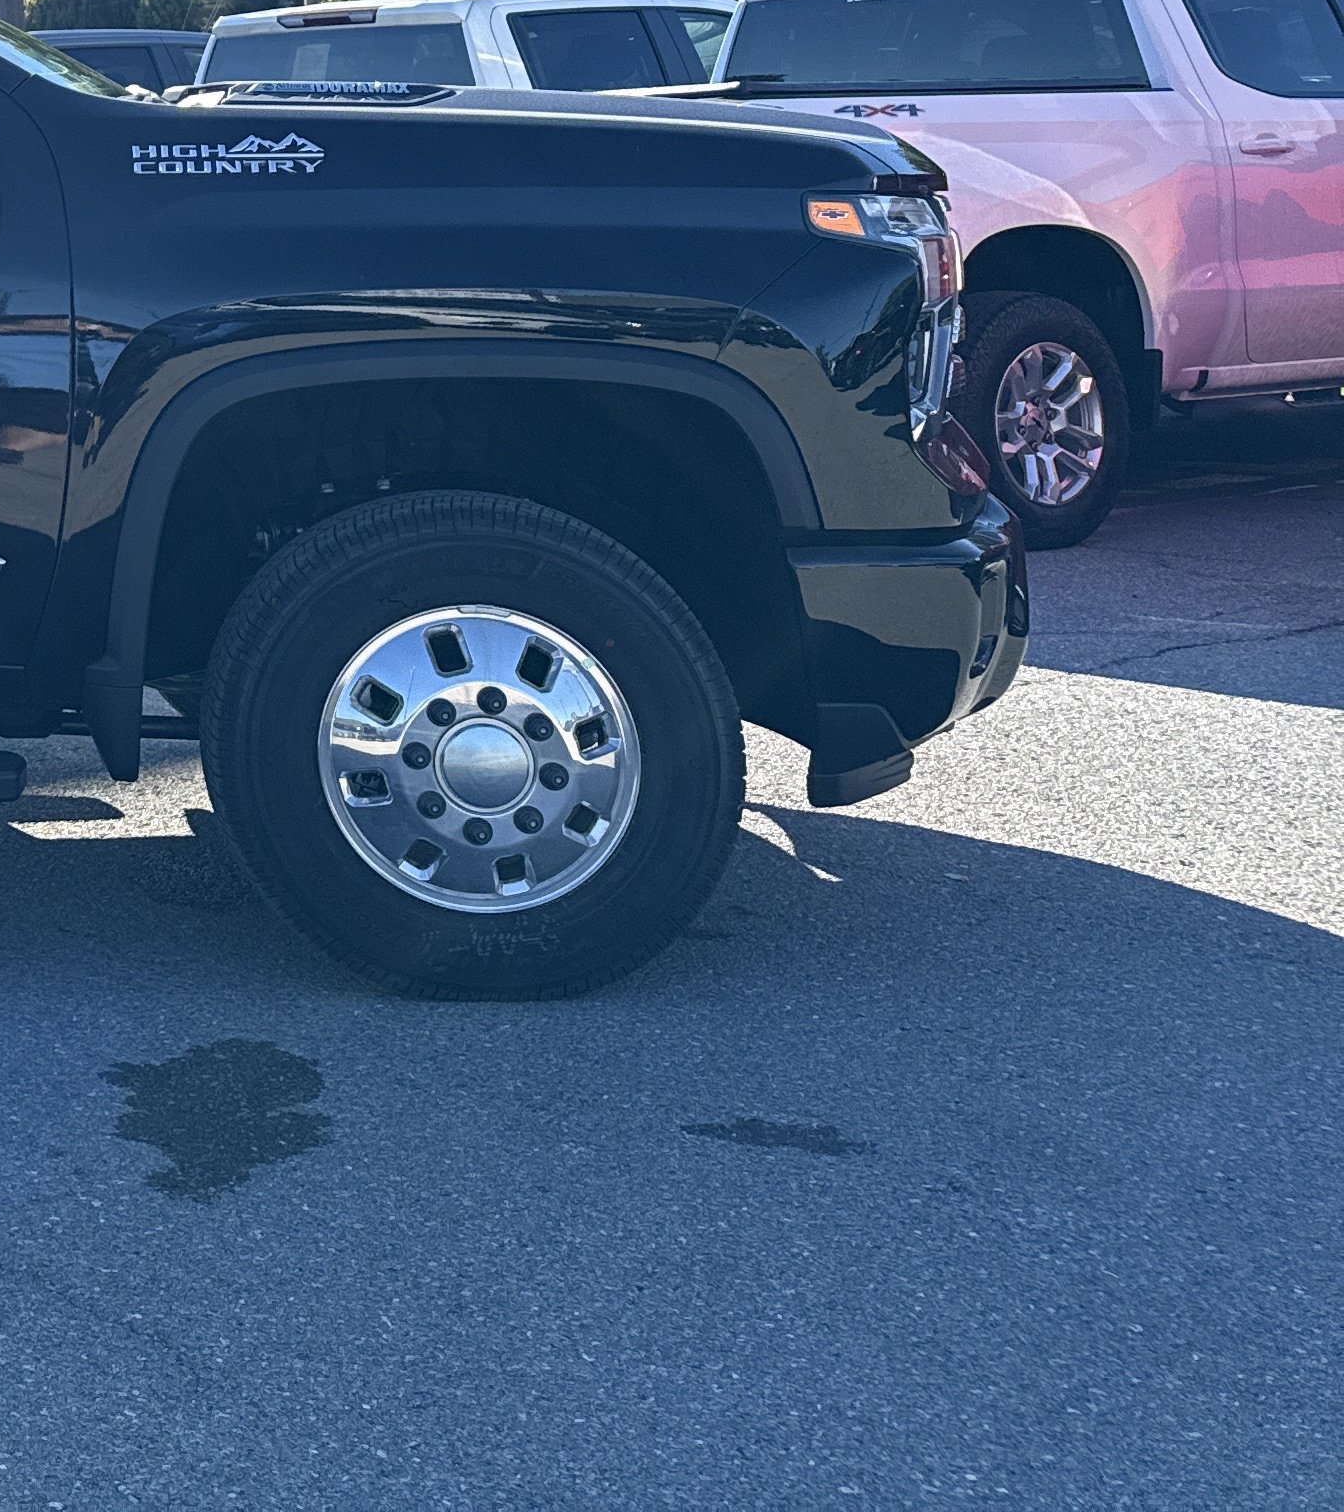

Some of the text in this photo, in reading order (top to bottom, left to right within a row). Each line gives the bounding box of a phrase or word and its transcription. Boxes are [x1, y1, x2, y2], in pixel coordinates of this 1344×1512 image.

[315, 81, 410, 93] DURAMAX
[132, 144, 226, 158] HIGH
[133, 160, 323, 174] COUNTRY
